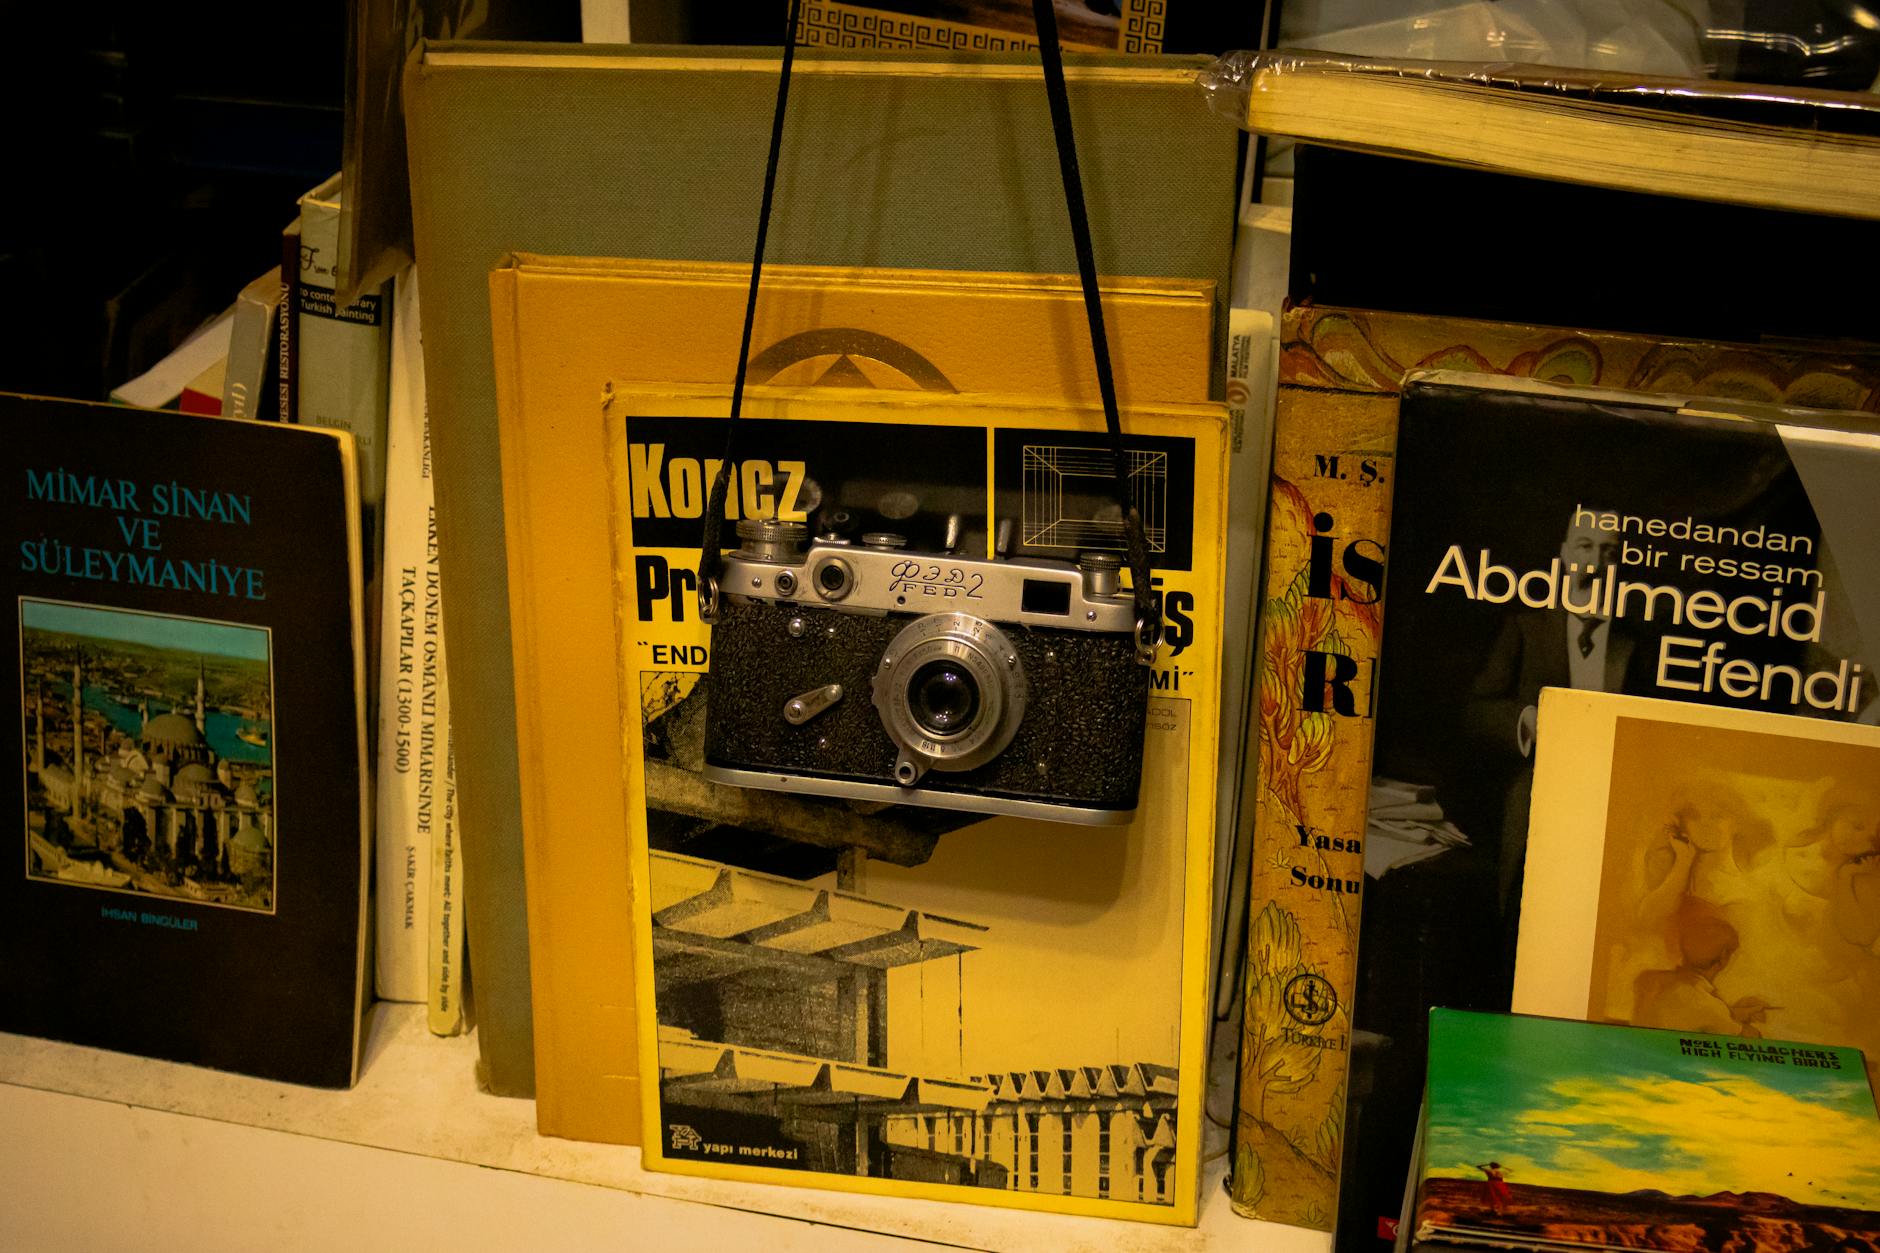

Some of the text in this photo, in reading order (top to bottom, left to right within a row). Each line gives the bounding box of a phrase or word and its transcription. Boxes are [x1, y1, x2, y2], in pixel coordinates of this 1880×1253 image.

[301, 299, 333, 315] Turkish
[1314, 455, 1347, 480] M.
[25, 466, 252, 525] MİMAR SİNAN
[117, 516, 162, 551] VE
[1575, 503, 1813, 555] hanedandan
[20, 537, 267, 601] SÜLEYMANİYE
[1621, 541, 1824, 588] bir ressam
[902, 573, 985, 600] FED 2
[1425, 544, 1828, 644] Abdülmecid
[421, 640, 437, 717] OSMANLI
[1656, 634, 1862, 714] Efendi
[395, 678, 413, 775] (1300-1500)
[1294, 825, 1362, 854] Yasa
[1290, 865, 1361, 894] Sonu
[1681, 1047, 1841, 1070] HIGH FLYING BIRDS
[703, 1142, 798, 1160] yapı merkezi
